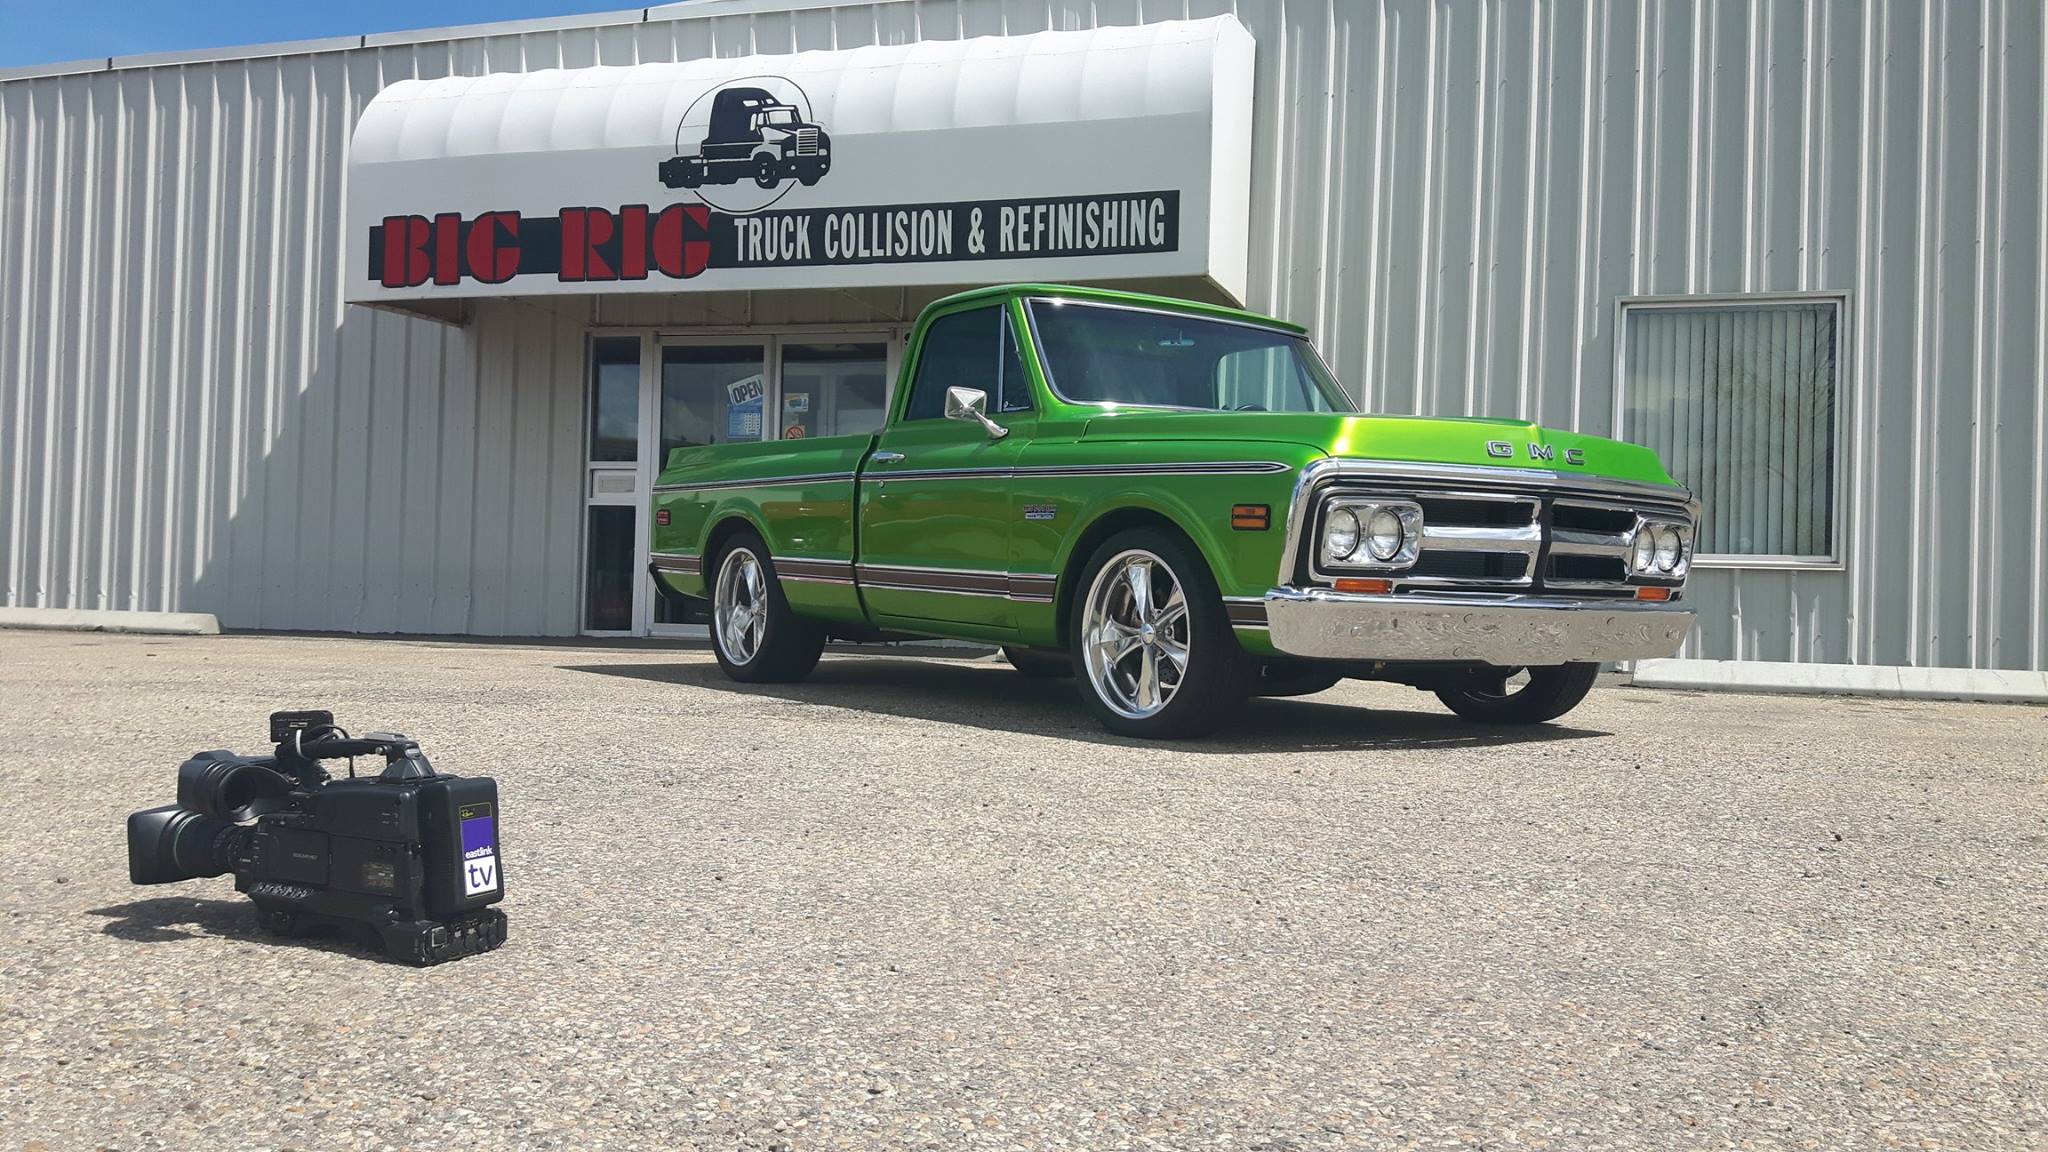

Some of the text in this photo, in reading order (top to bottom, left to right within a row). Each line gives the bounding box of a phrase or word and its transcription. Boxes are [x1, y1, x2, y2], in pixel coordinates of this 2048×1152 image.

[382, 197, 1165, 288] BIG RIG TRUCK COLLISION & REFINISHING
[733, 379, 762, 404] OPEN
[465, 845, 493, 859] eastlink
[468, 864, 492, 888] tv
